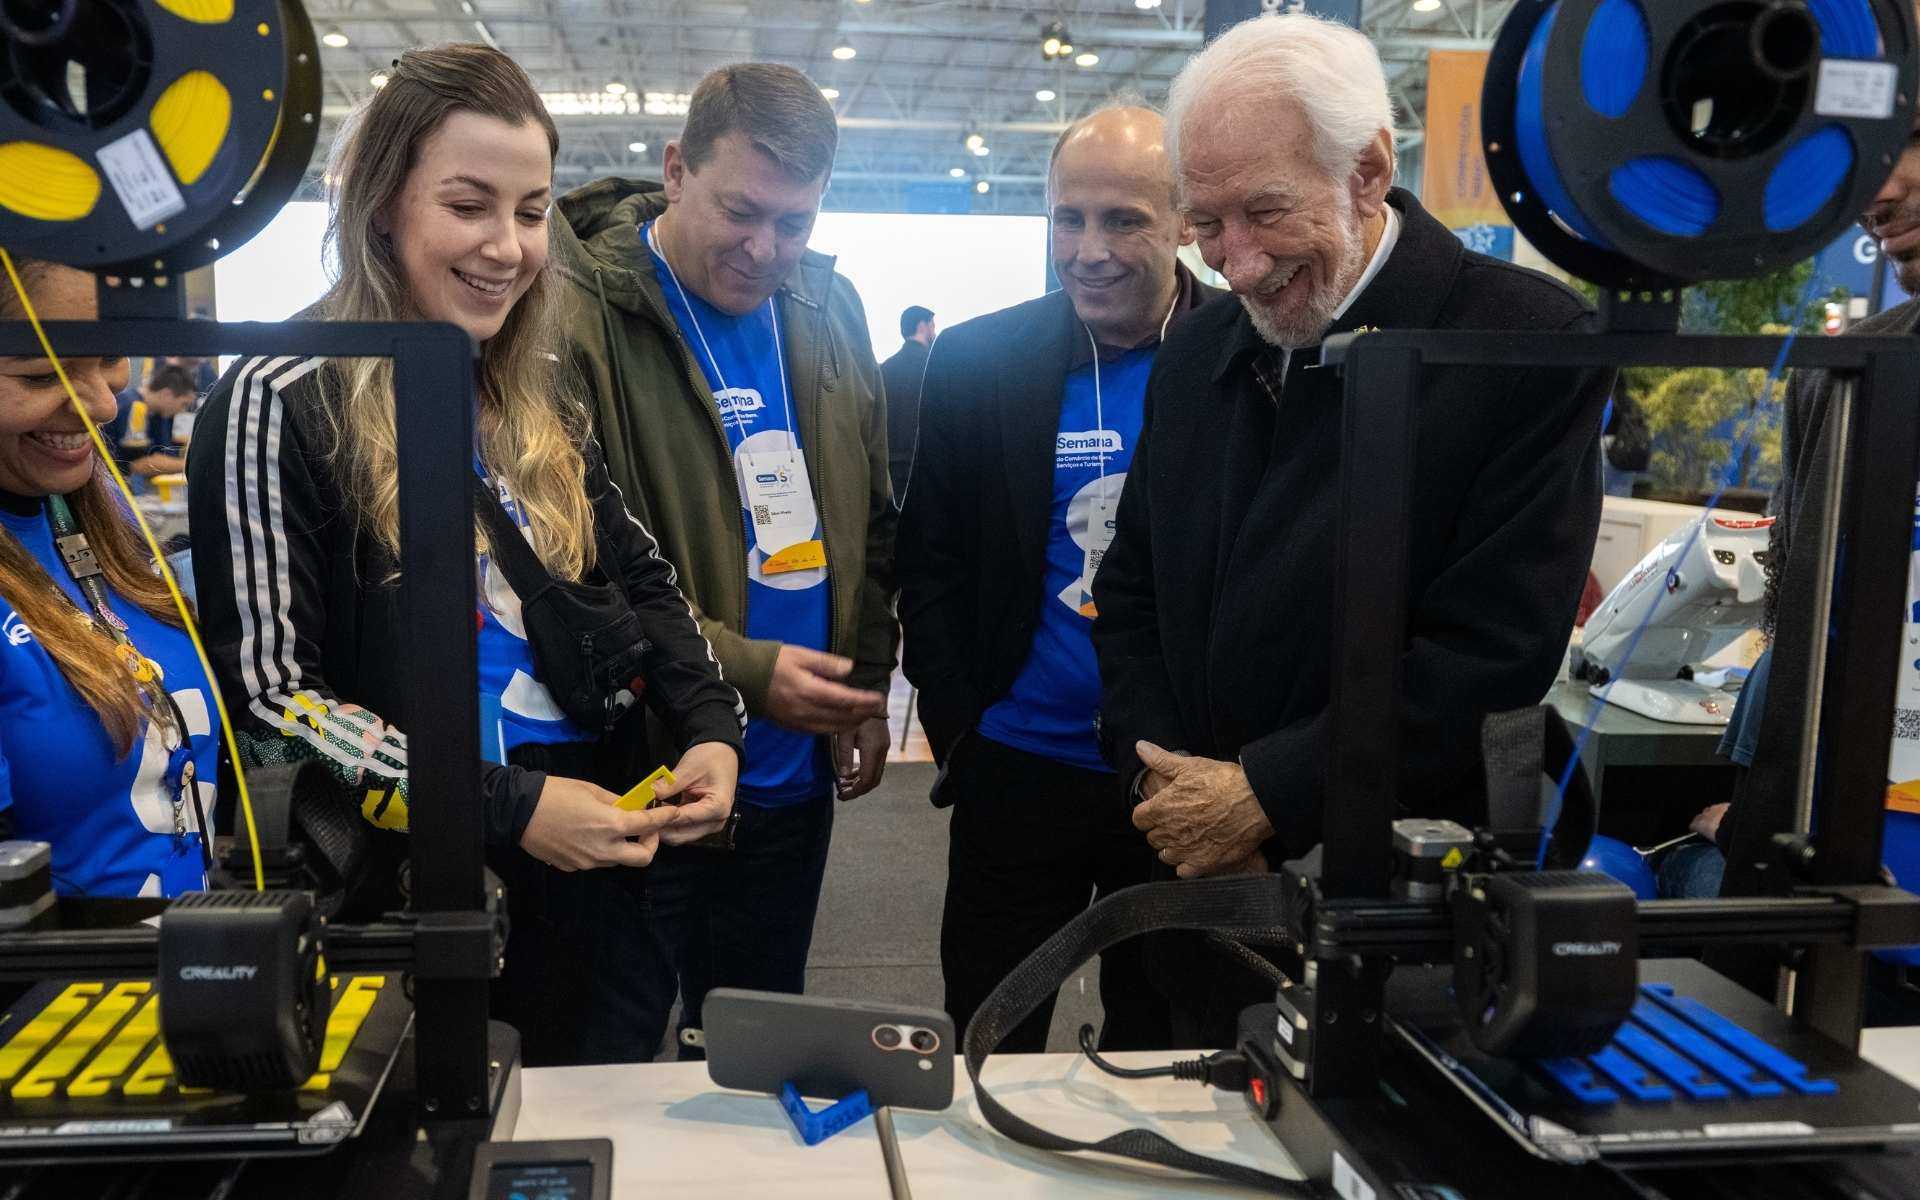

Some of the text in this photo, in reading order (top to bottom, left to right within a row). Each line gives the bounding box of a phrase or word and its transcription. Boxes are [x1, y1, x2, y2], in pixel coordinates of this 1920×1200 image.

[1057, 437, 1112, 449] Semana
[1551, 941, 1623, 956] CREALITY
[180, 965, 258, 980] CREALITY
